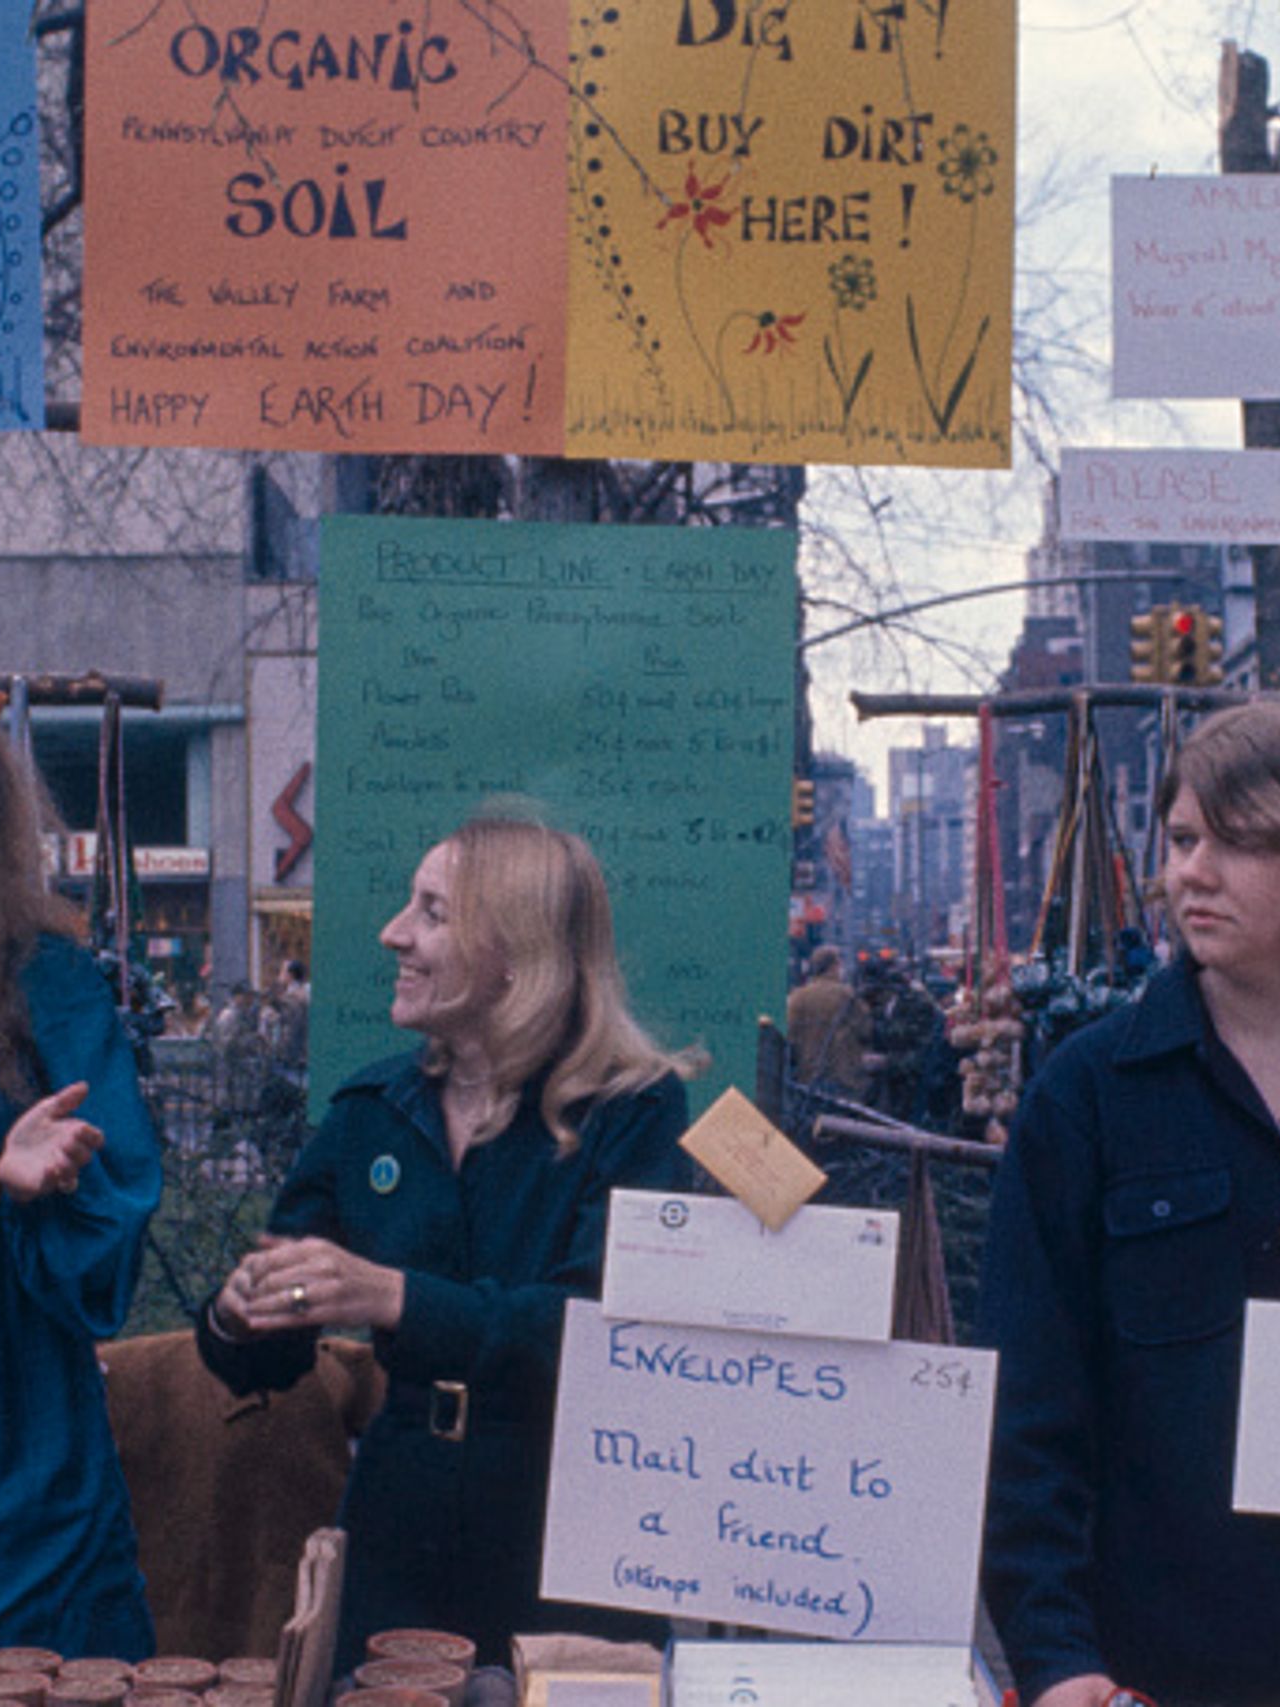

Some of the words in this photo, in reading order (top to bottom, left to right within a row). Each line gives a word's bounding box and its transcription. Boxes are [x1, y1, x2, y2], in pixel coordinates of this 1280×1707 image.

[121, 117, 297, 148] PENNSYLVANIA
[321, 118, 405, 148] DUTCH
[421, 119, 546, 149] COUNTRY
[658, 109, 765, 157] BUY
[140, 279, 185, 306] THE
[208, 281, 299, 307] VALLEY
[327, 281, 389, 312] FARM
[445, 282, 495, 302] AND
[111, 334, 284, 361] ENVIRONMENTAL
[304, 335, 378, 359] ACTION
[405, 324, 535, 356] COALITION
[111, 387, 209, 428] HAPPY
[260, 376, 383, 438] EARTH
[406, 363, 536, 434] DAY!
[1086, 460, 1240, 502] PLEASE
[376, 540, 507, 582] PRODUCT
[538, 555, 599, 586] LINE
[609, 1322, 847, 1401] ENVELOPES
[910, 1358, 974, 1396] 25¢
[593, 1428, 701, 1480] Mail
[730, 1450, 814, 1493] dirt
[849, 1458, 892, 1500] to
[639, 1511, 668, 1537] a
[613, 1555, 701, 1596] (stamps
[732, 1577, 874, 1638] included)
